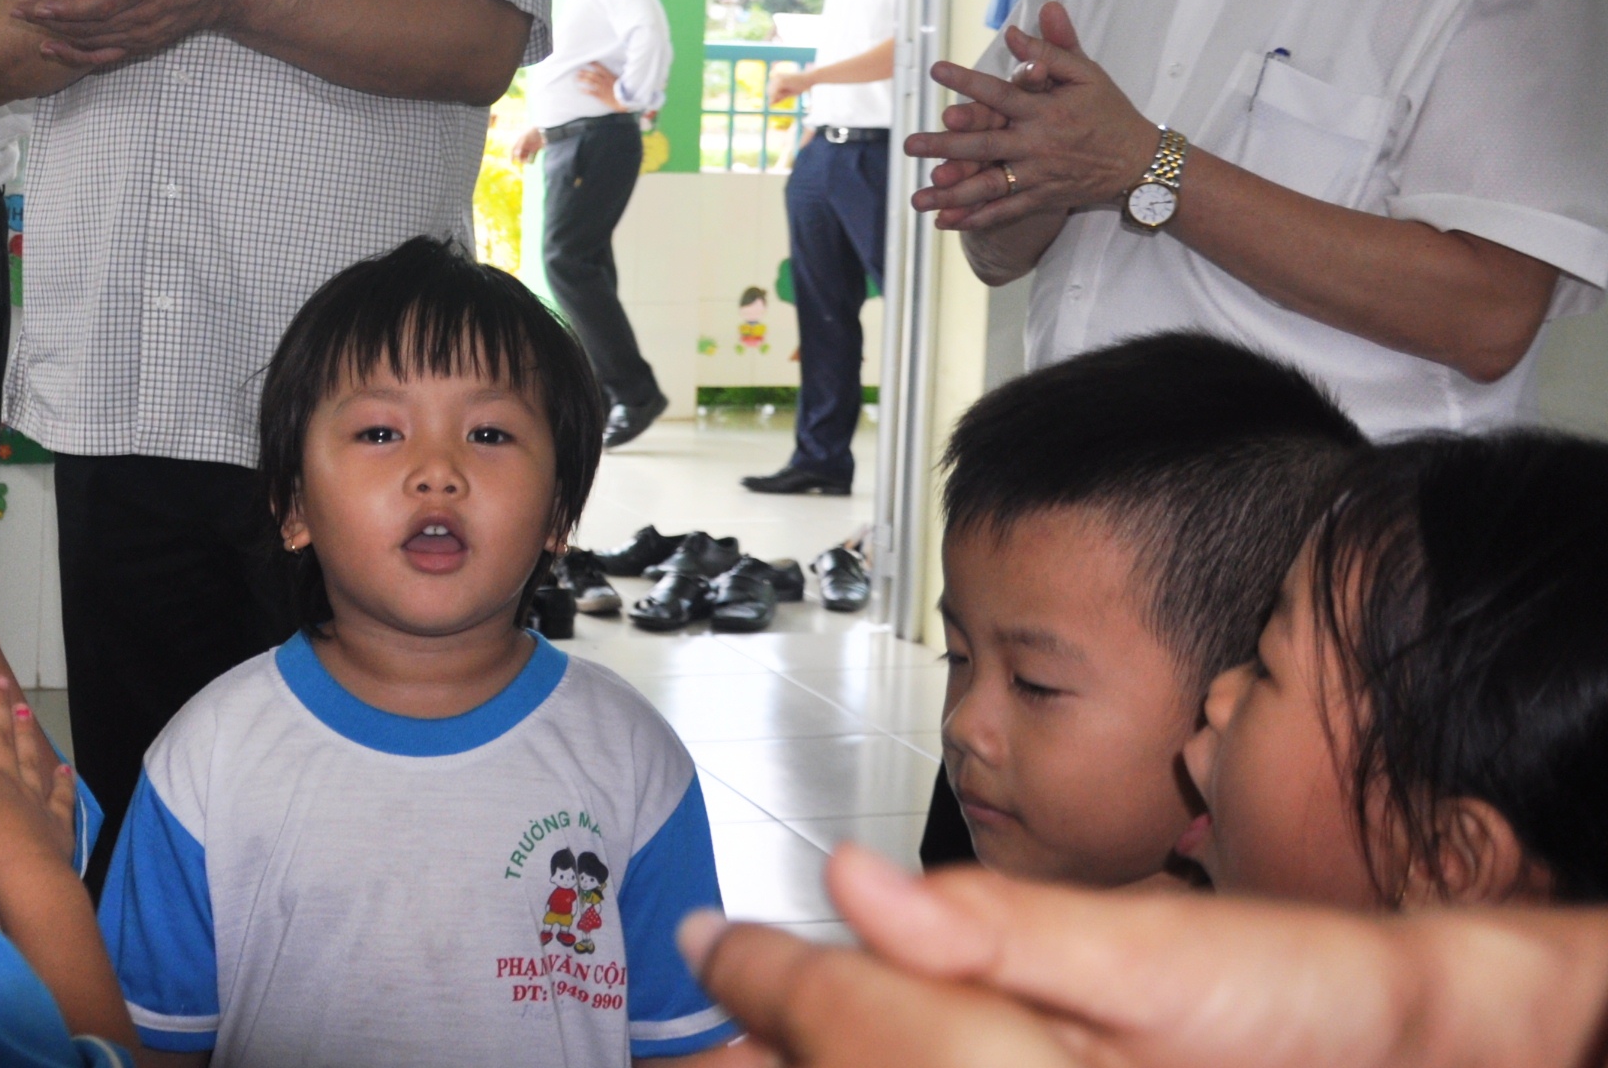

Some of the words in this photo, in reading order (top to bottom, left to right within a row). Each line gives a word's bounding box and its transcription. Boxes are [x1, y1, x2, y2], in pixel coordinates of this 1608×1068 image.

[504, 810, 571, 880] TRƯỜNG
[547, 953, 591, 982] VĂN
[594, 961, 626, 989] CỘI
[512, 985, 548, 1002] ĐT:
[552, 981, 589, 1003] 949
[591, 992, 623, 1010] 990
